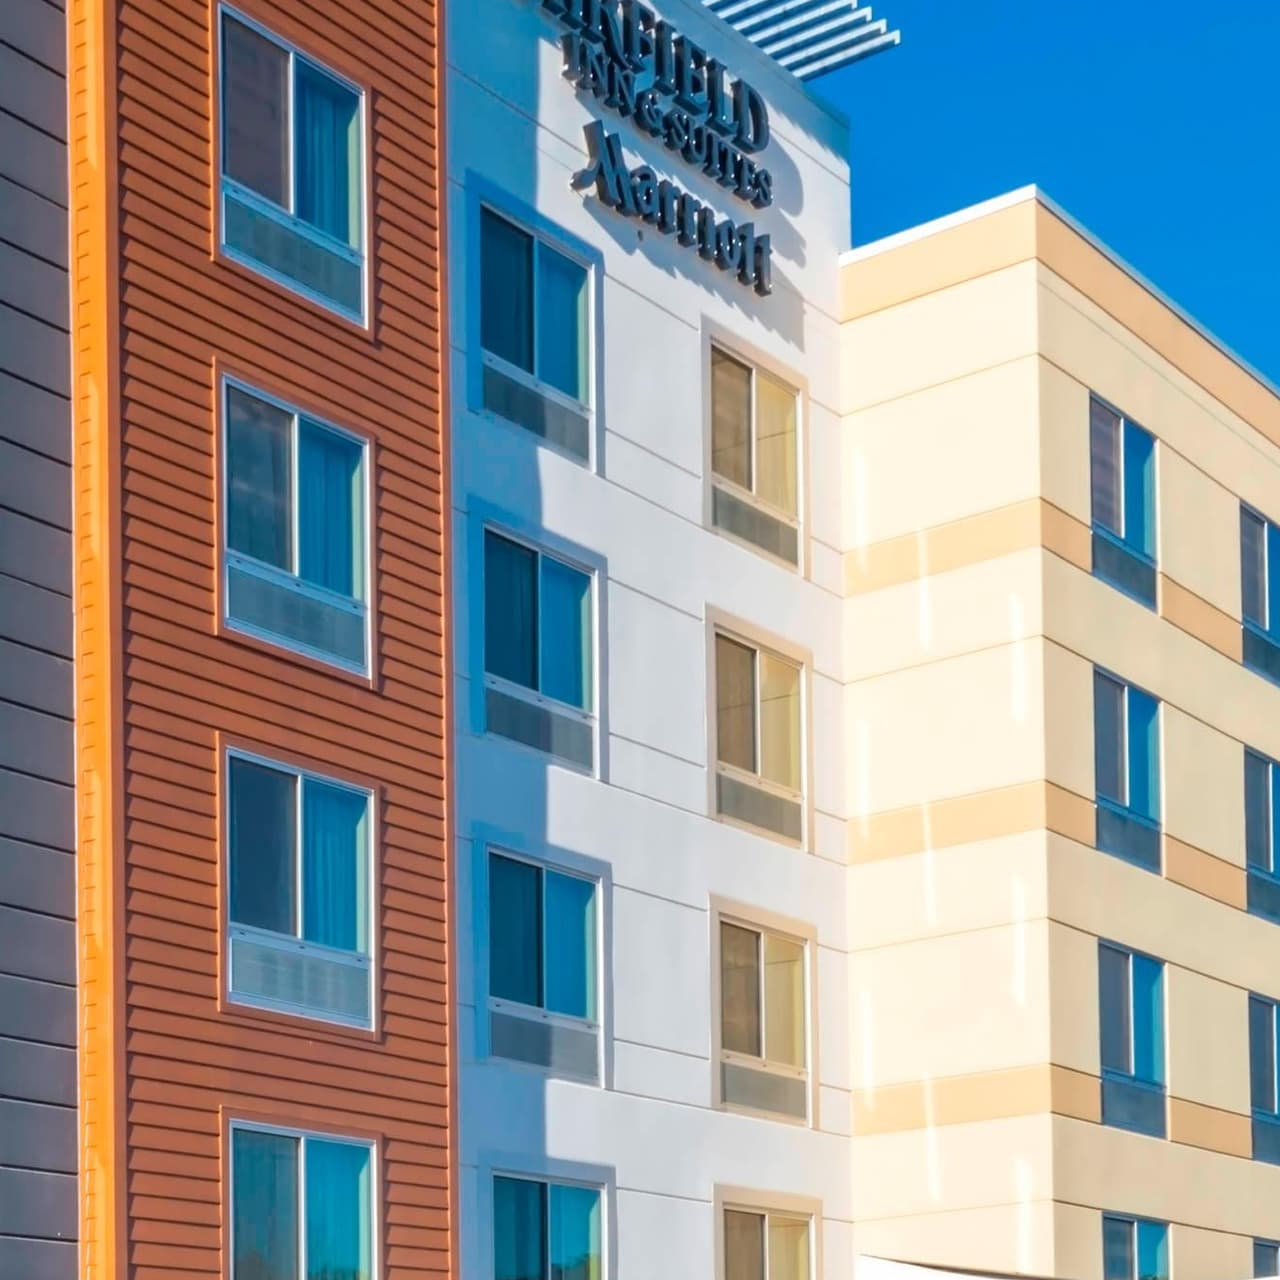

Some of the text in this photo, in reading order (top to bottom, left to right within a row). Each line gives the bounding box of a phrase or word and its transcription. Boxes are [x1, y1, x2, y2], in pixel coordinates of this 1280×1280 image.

[562, 31, 773, 210] INN & SUITES
[570, 119, 773, 297] Marriott
